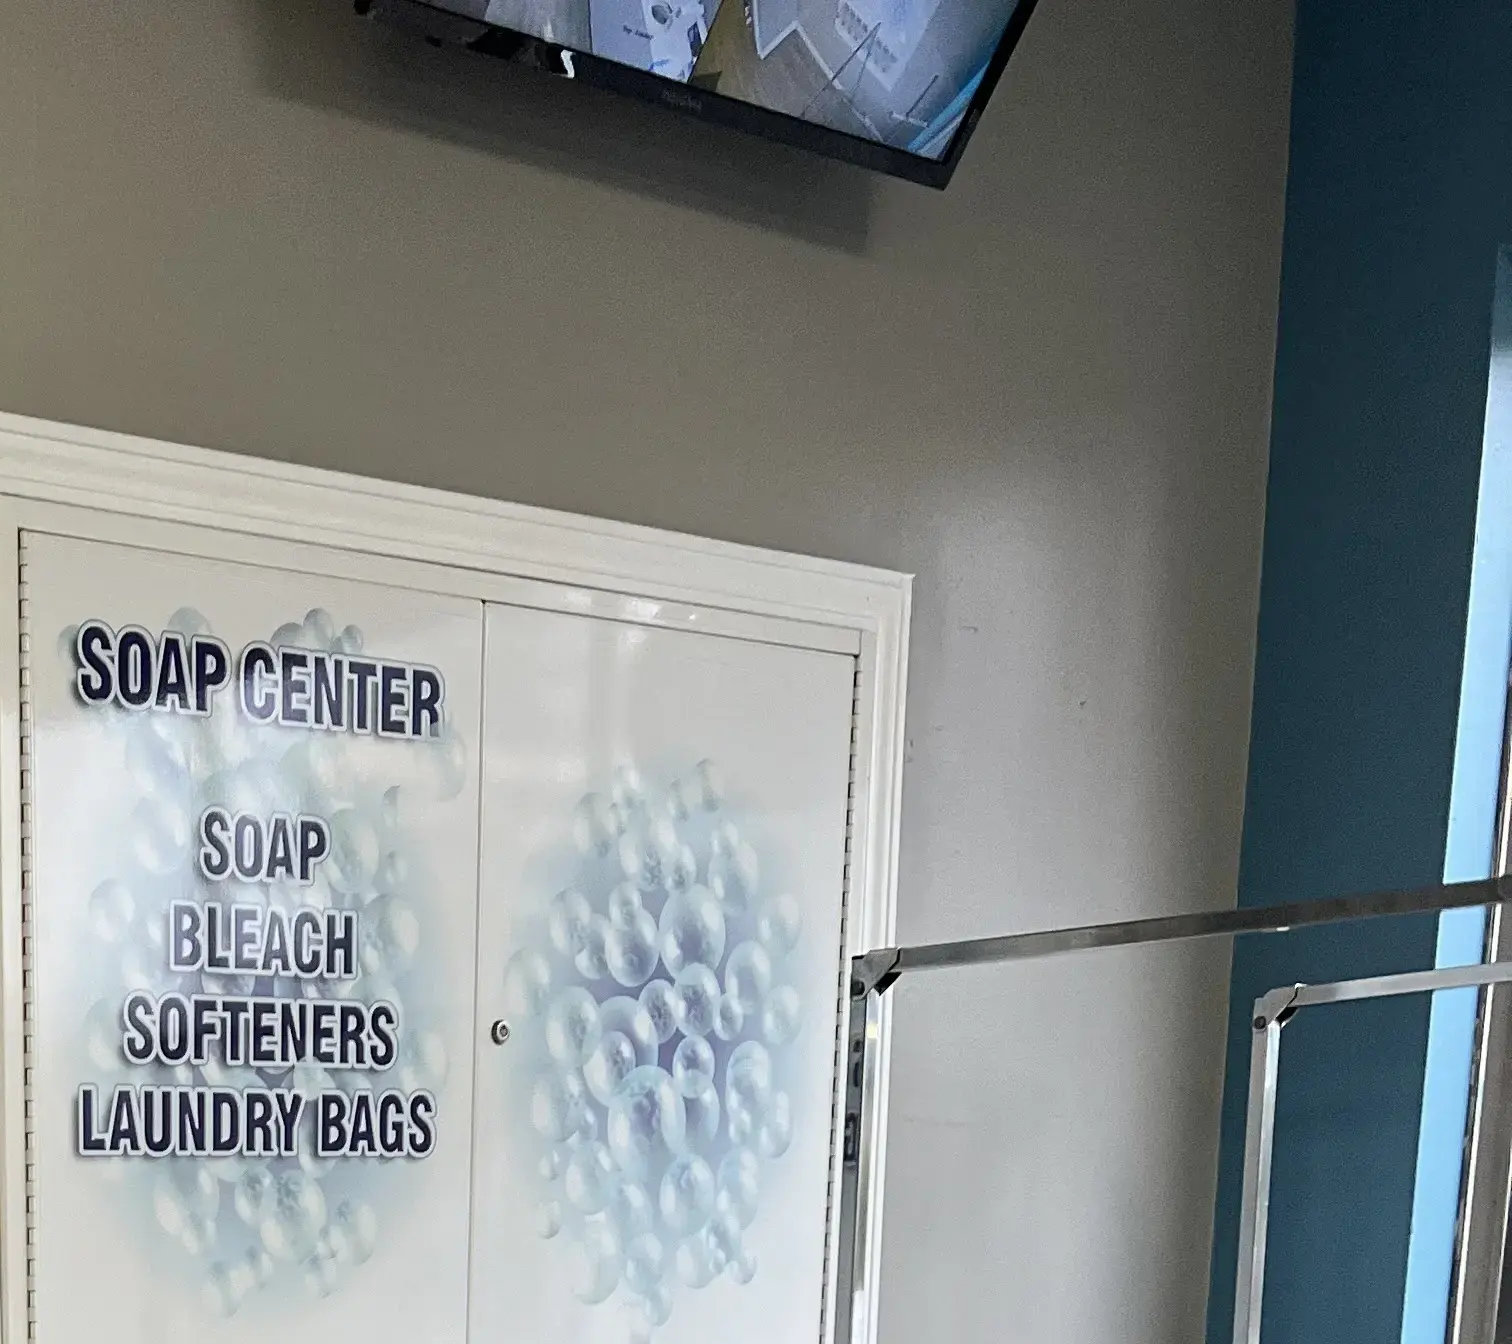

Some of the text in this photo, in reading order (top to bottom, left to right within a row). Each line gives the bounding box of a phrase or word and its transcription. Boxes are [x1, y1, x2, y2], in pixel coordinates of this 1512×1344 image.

[77, 619, 445, 741] SOAP CENTER
[202, 807, 329, 884] SOAP
[170, 901, 357, 979] BLEACH
[124, 990, 398, 1071] SOFTENERS
[78, 1082, 437, 1157] LAUNDRY BAGS
